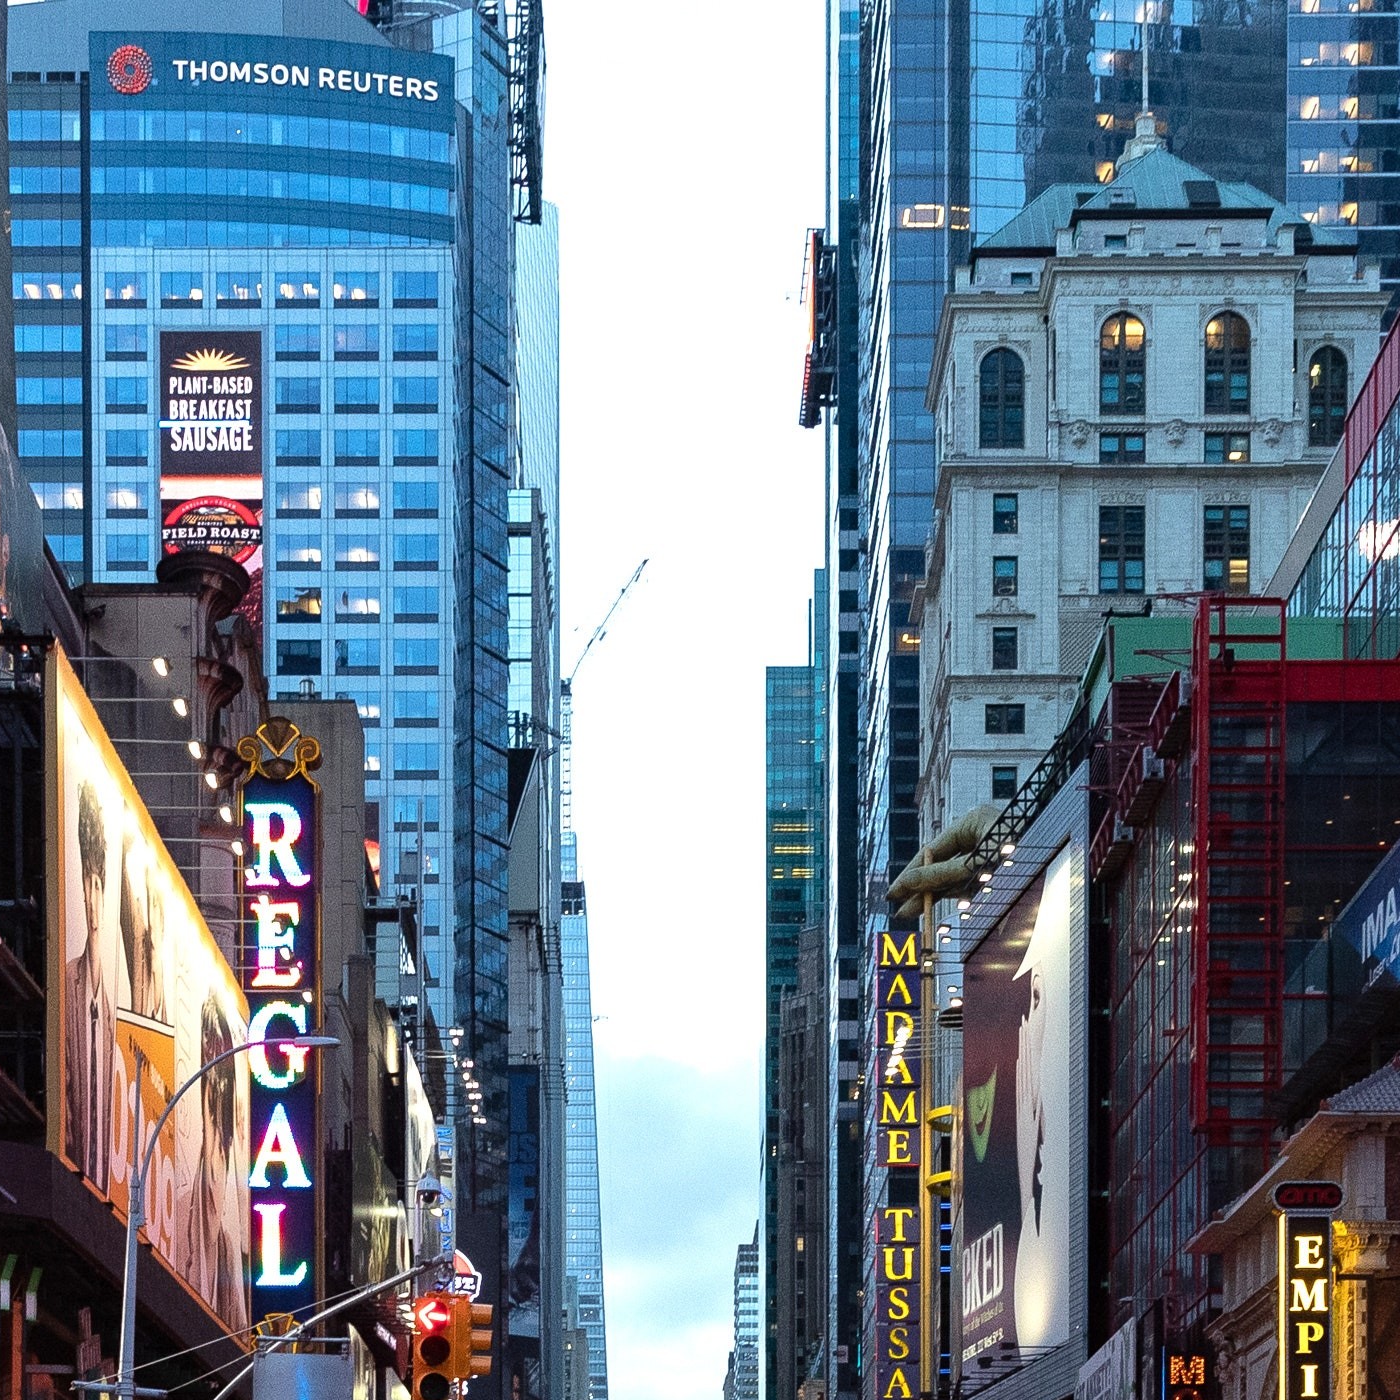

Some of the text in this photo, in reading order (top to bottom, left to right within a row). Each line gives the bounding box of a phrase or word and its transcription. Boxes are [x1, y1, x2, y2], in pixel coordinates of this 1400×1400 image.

[172, 59, 439, 102] THOMSON REUTERS
[169, 375, 253, 396] PLANT-BASED
[169, 399, 252, 421] BREAKFAST
[169, 426, 253, 453] SAUSAGE
[162, 527, 261, 540] FIELD ROAST
[244, 800, 314, 1288] REGAL
[879, 933, 919, 1164] MADAME
[962, 1222, 1004, 1318] CKED
